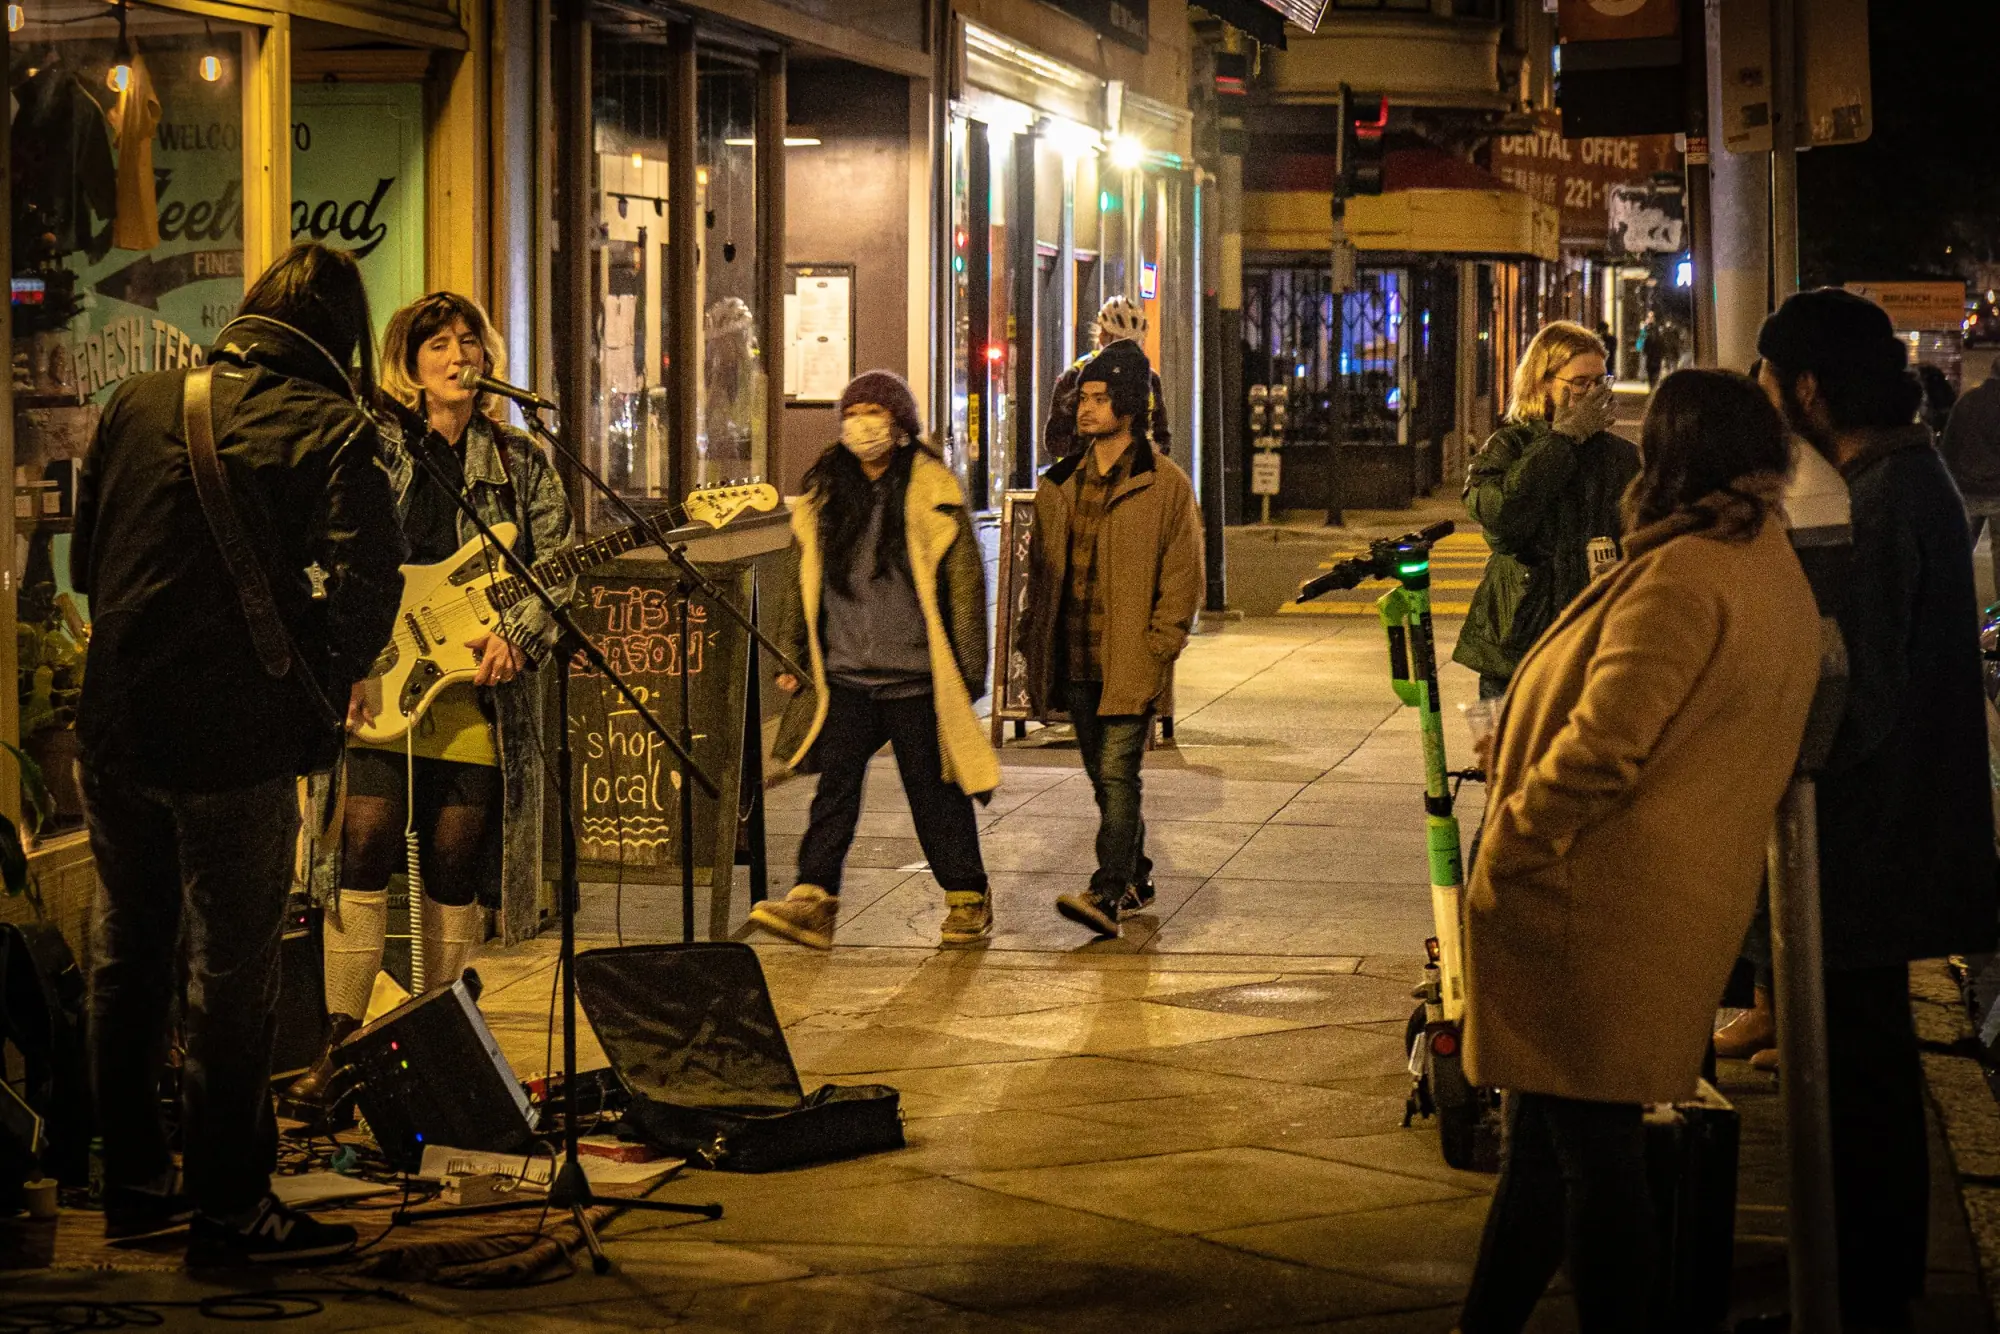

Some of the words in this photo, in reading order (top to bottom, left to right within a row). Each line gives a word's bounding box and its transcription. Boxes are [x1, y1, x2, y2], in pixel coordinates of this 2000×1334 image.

[157, 121, 243, 151] WELCO
[291, 122, 311, 151] O
[1500, 130, 1572, 162] DENTAL
[1580, 137, 1640, 170] OFFICE
[1563, 176, 1611, 210] 221-1
[194, 252, 243, 276] FINE
[201, 304, 236, 328] HO
[72, 315, 146, 406] FRESH
[568, 631, 703, 678] ASON
[587, 720, 665, 776] shop
[582, 759, 664, 812] local
